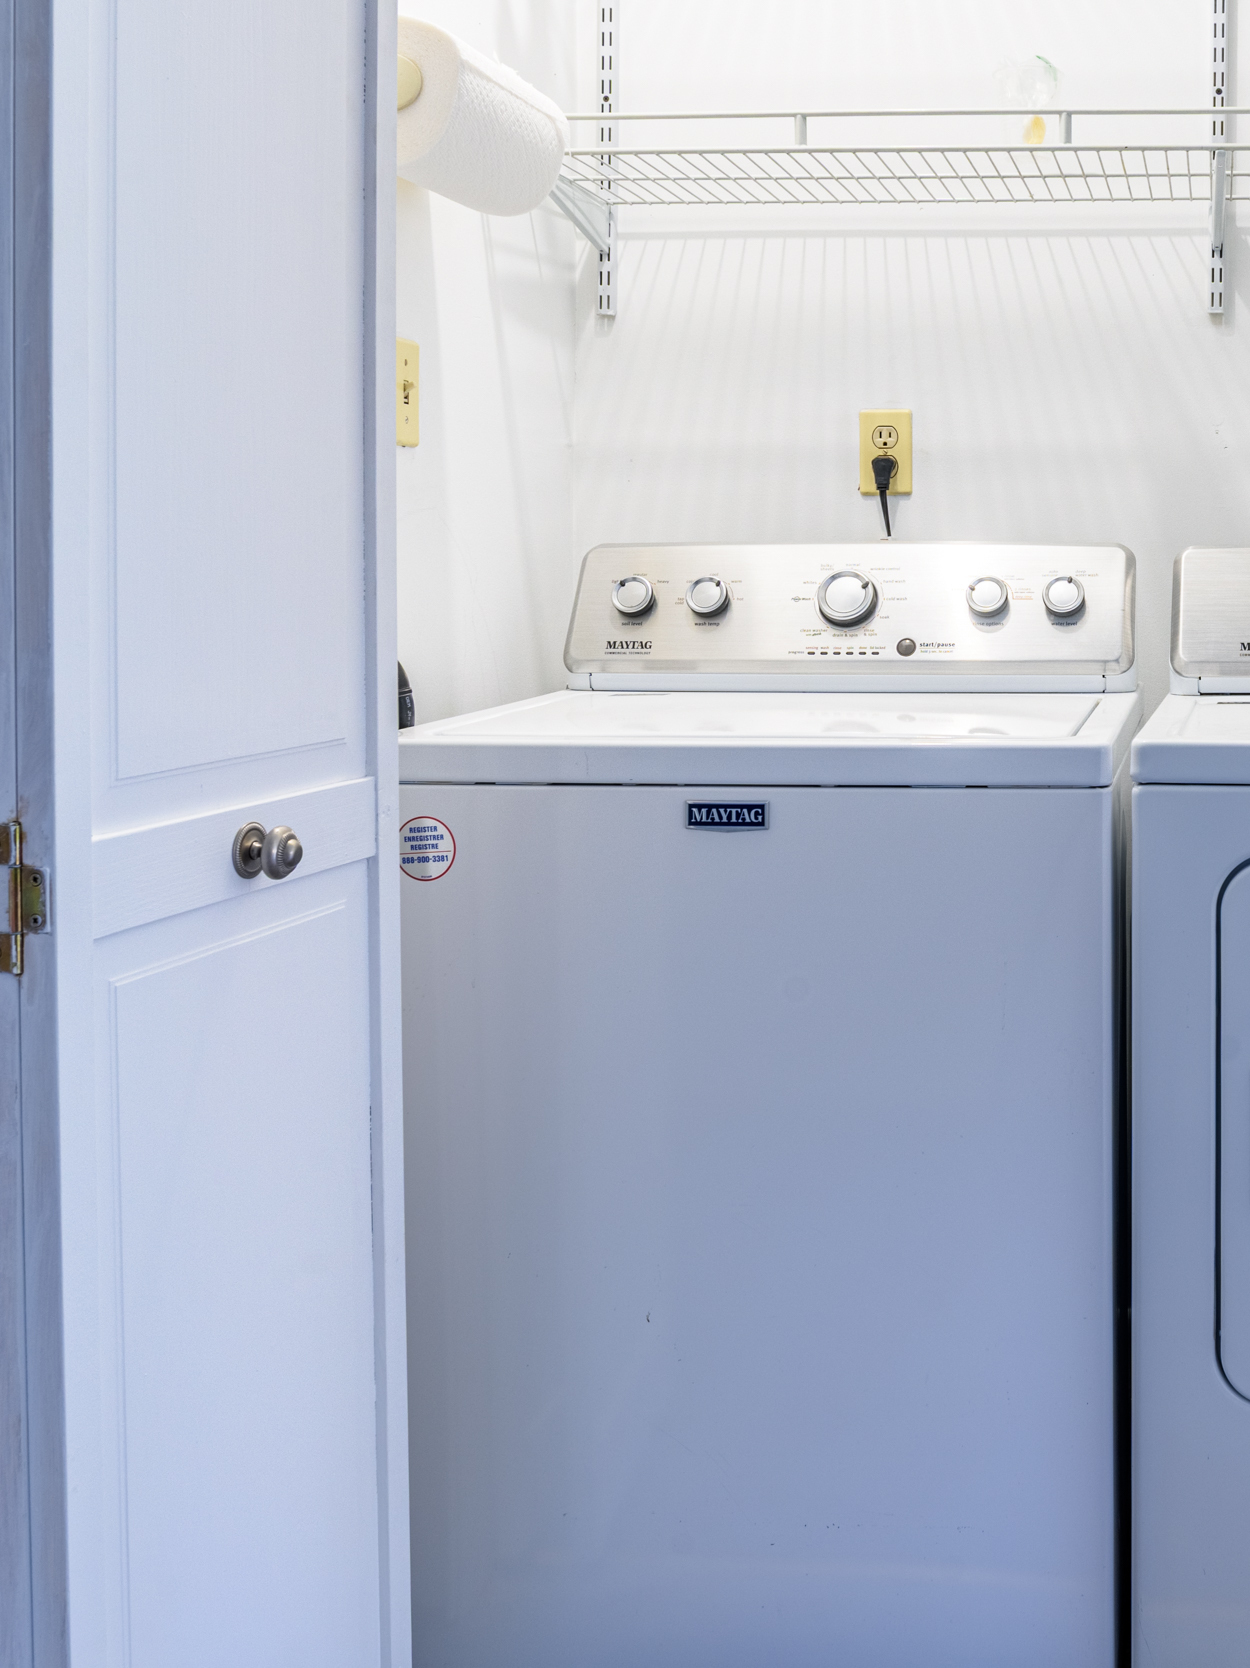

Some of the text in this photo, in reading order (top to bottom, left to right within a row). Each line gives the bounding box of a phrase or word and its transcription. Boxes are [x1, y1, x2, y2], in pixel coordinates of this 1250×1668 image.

[605, 641, 652, 650] MAYTAG
[691, 808, 763, 823] MAYTAG
[404, 834, 444, 842] ENREGISTRER
[402, 855, 448, 864] 888-900-3381
